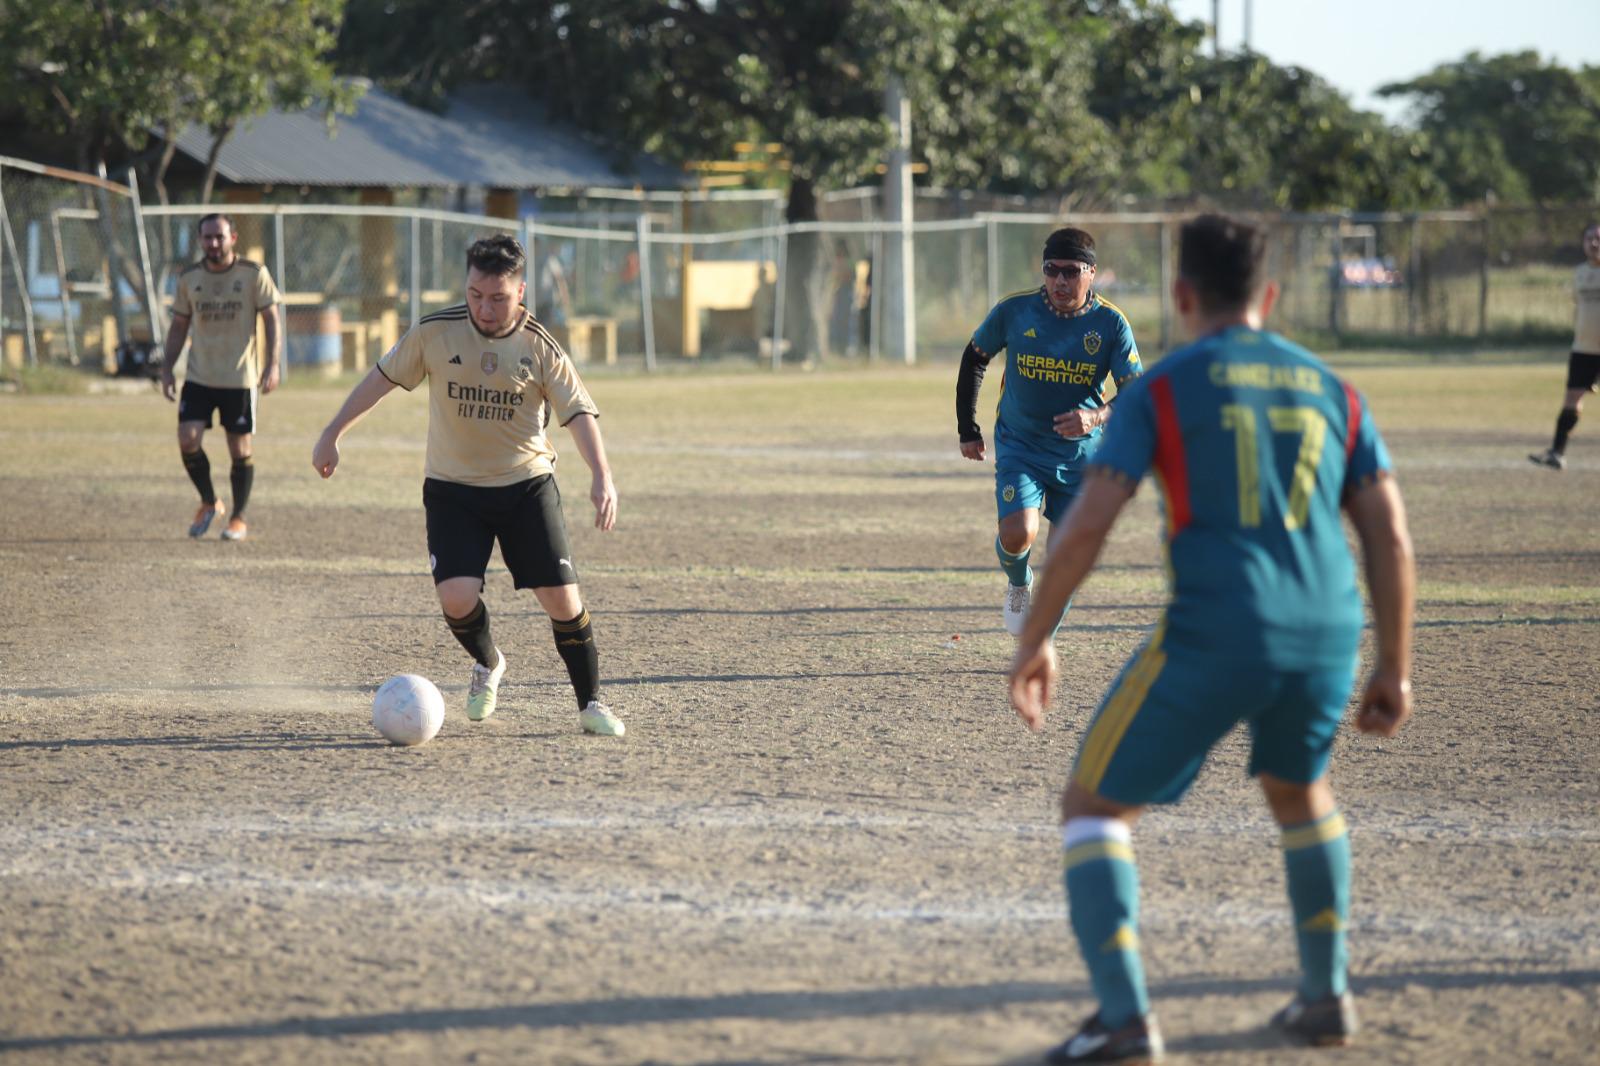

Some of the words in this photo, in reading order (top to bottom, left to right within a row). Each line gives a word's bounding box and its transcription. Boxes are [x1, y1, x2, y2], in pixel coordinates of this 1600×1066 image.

[1017, 353, 1097, 375] HERBALIFE
[1018, 365, 1094, 386] NUTRITION
[447, 381, 525, 406] Emirates
[458, 403, 476, 418] FLY
[477, 405, 516, 421] BETTER
[1220, 404, 1328, 532] 17
